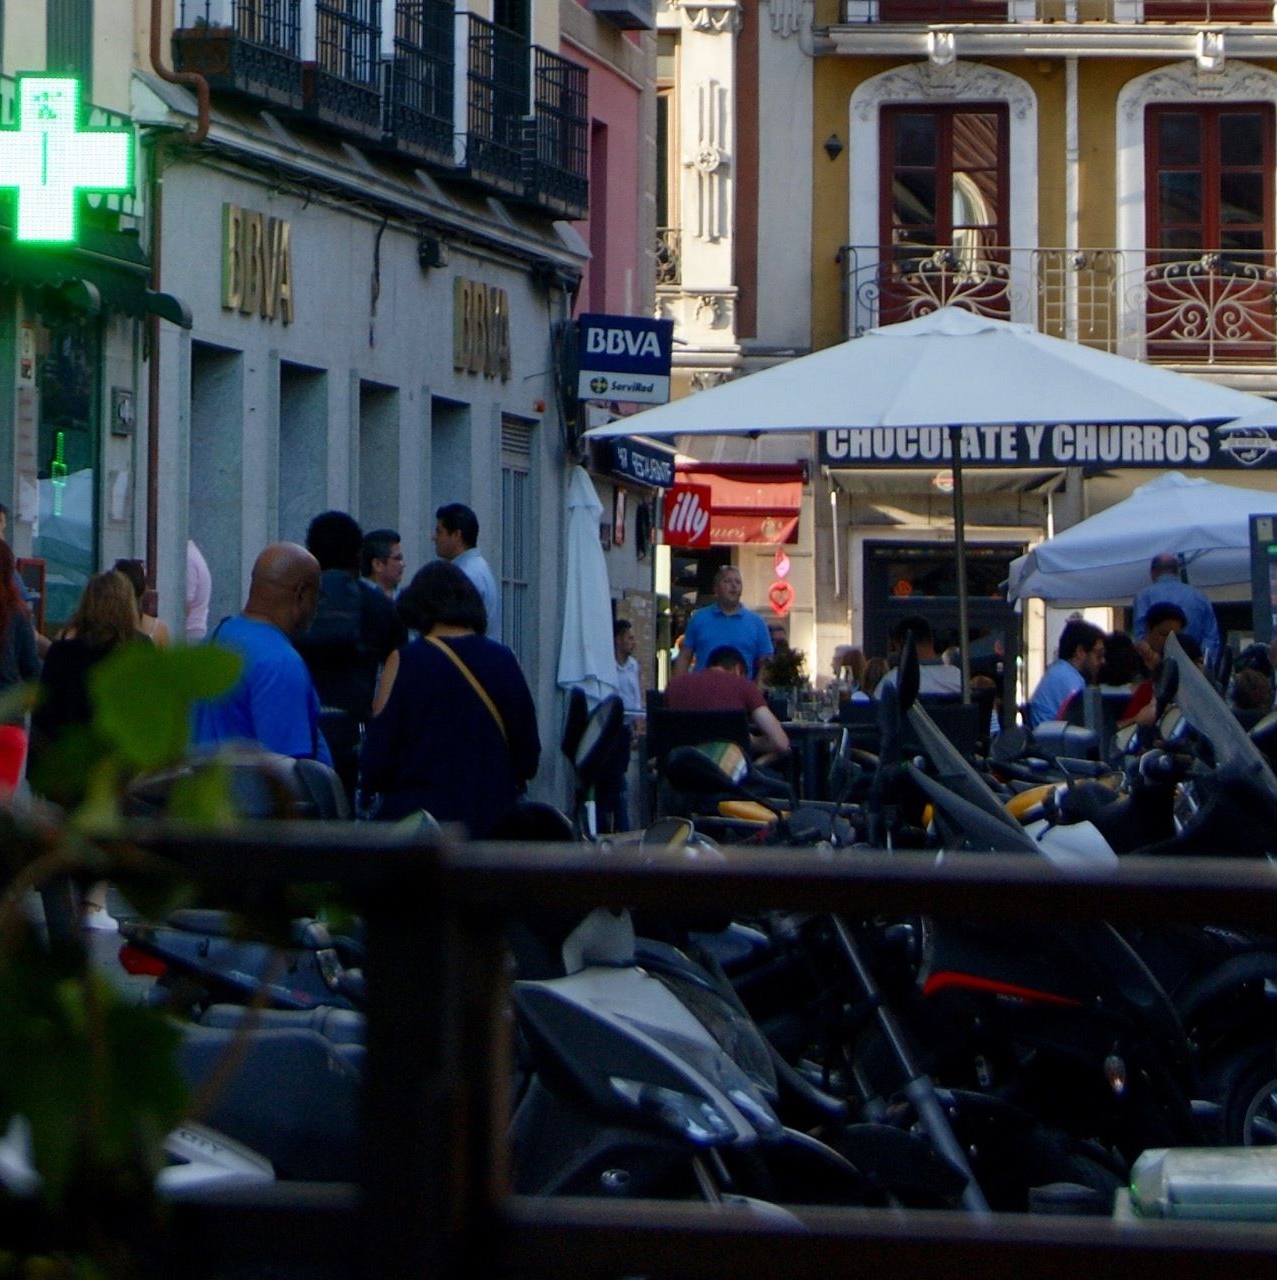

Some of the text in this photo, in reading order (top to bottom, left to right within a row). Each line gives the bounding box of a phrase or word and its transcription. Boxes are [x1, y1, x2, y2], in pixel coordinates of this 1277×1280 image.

[222, 202, 294, 326] BBVA
[454, 275, 511, 384] BBVA
[586, 327, 662, 358] BBVA
[610, 380, 654, 393] ServiRed
[1025, 426, 1046, 461] Y
[1052, 424, 1211, 463] CHURROS
[667, 491, 710, 544] illy
